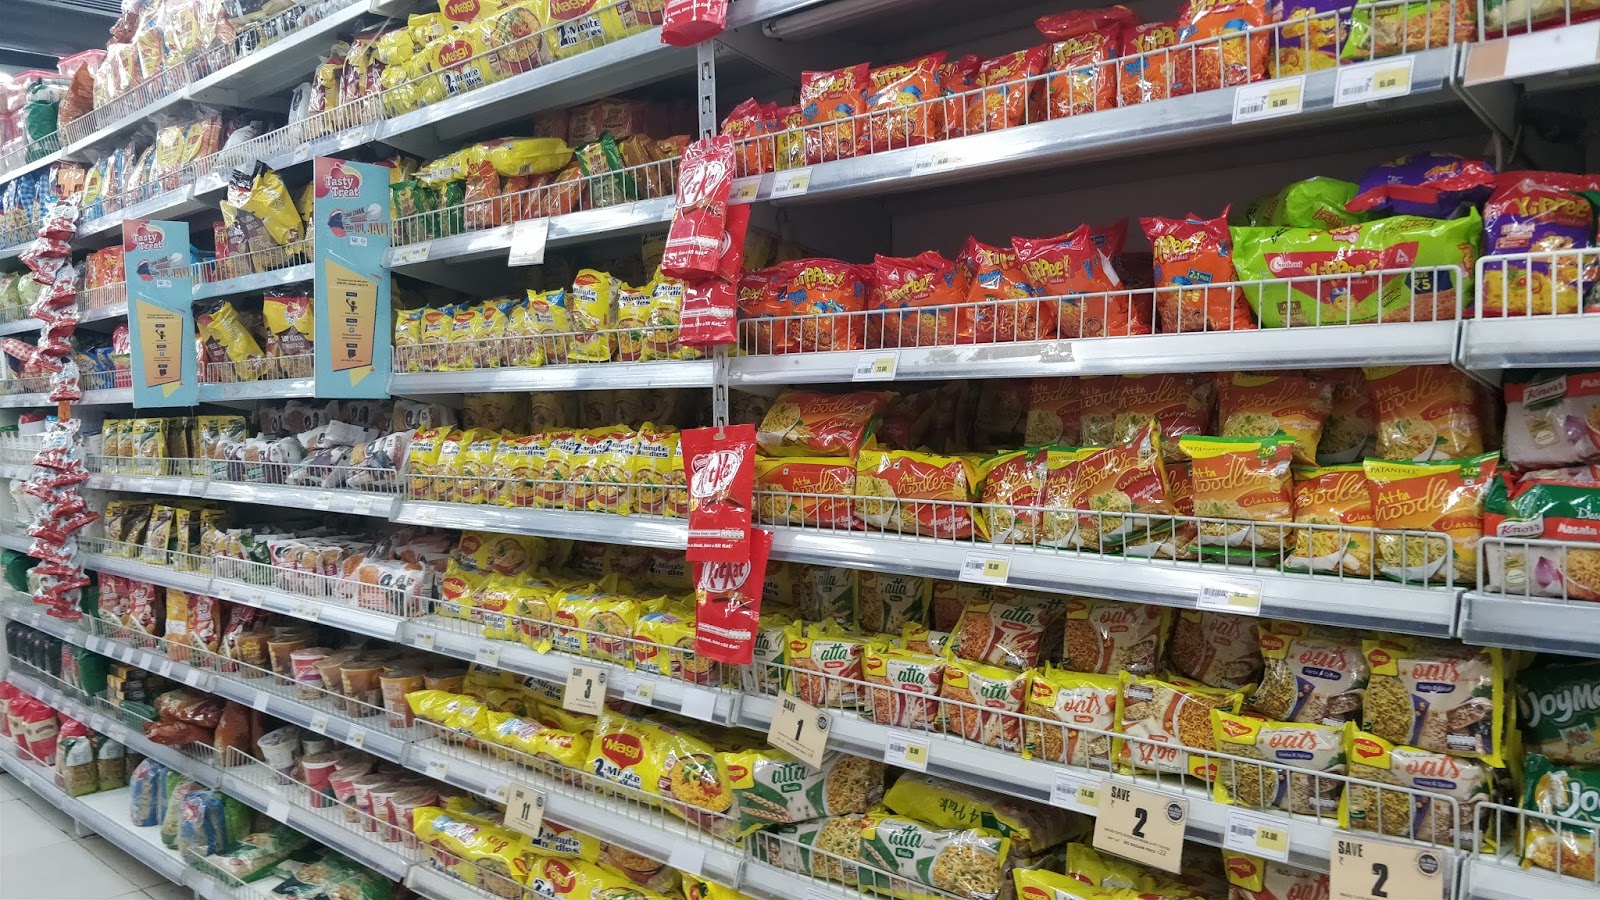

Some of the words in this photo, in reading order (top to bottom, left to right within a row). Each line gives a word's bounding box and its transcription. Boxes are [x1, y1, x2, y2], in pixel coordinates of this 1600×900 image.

[449, 1, 476, 16] Maggi
[440, 47, 469, 65] Maggi
[1272, 99, 1288, 107] 15.00
[325, 176, 354, 189] Tasty
[332, 187, 360, 197] Treat
[132, 234, 158, 244] Tasty
[139, 242, 163, 251] Treat
[1153, 230, 1207, 263] iPPee!
[1527, 381, 1565, 401] Knorr
[1191, 468, 1217, 479] Atta
[1243, 496, 1281, 507] Classic
[1377, 492, 1410, 504] Atta
[1499, 523, 1541, 536] Knorr
[1557, 523, 1598, 535] Masala
[885, 580, 911, 597] atta
[1000, 605, 1037, 626] atta
[1100, 607, 1138, 625] oats
[1210, 617, 1246, 640] oats
[820, 643, 849, 661] atta
[1299, 647, 1349, 672] oats
[897, 665, 927, 685] atta
[1411, 660, 1462, 683] oats
[584, 679, 593, 699] 3
[783, 699, 797, 713] SAVE
[1063, 691, 1102, 715] oats
[795, 719, 804, 741] 1
[604, 737, 642, 759] Maggi
[1269, 731, 1318, 750] oats
[595, 757, 641, 783] 2-Minute
[771, 763, 810, 785] atta
[1404, 755, 1461, 780] oats
[1111, 786, 1131, 802] SAVE
[1559, 781, 1600, 819] Jo
[520, 802, 530, 820] 11
[1132, 808, 1148, 838] 2
[889, 826, 925, 849] atta
[1261, 830, 1278, 841] 24.00
[1338, 840, 1363, 857] SAVE
[1371, 863, 1388, 898] 2
